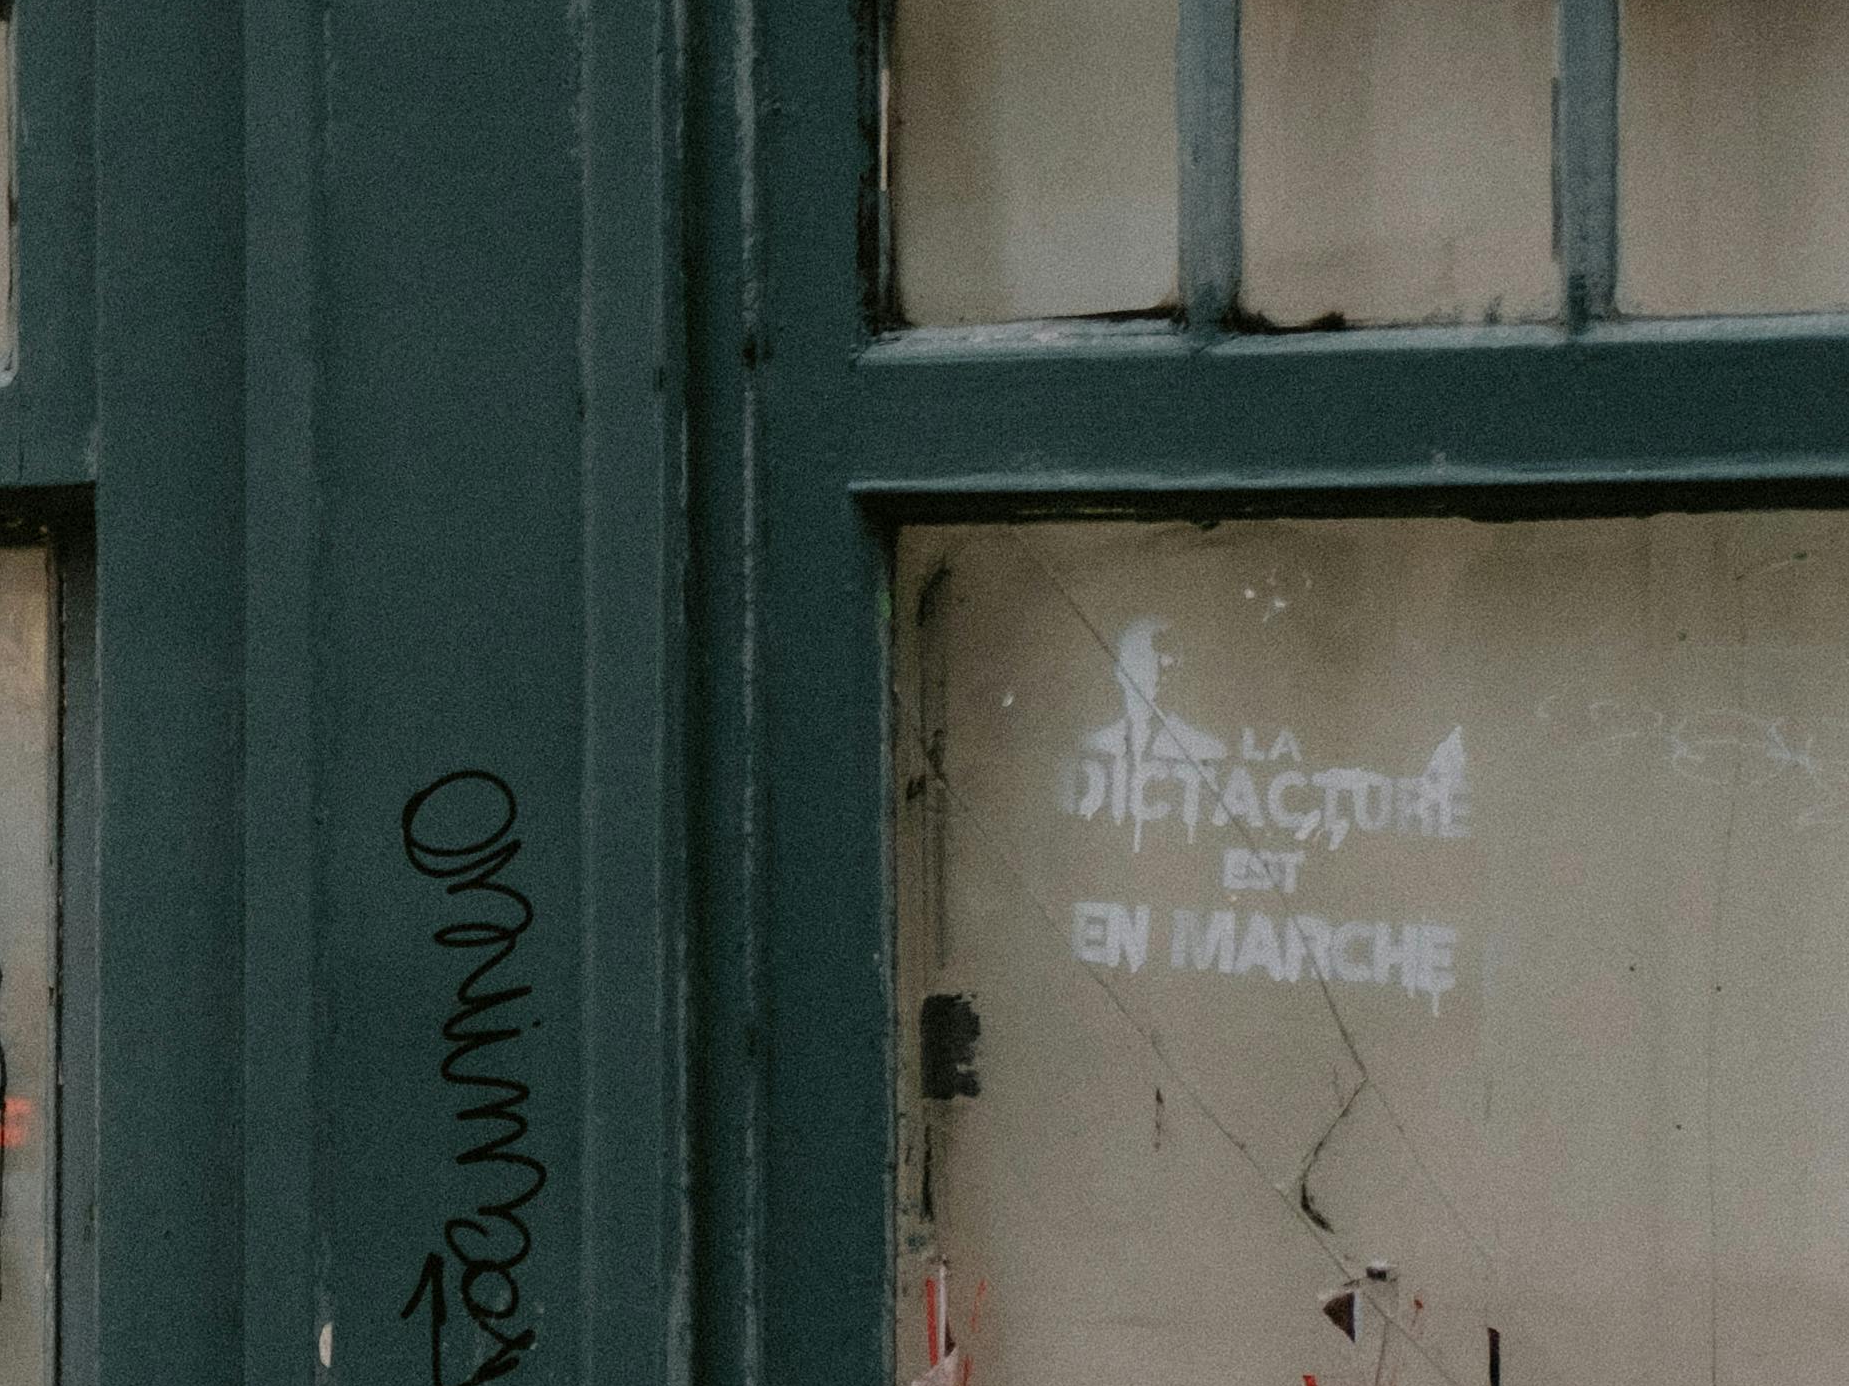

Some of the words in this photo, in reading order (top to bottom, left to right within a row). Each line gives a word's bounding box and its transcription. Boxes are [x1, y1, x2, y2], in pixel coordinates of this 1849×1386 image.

[1242, 727, 1301, 762] LA
[1071, 902, 1150, 973] EN
[1171, 910, 1456, 997] MARCHE
